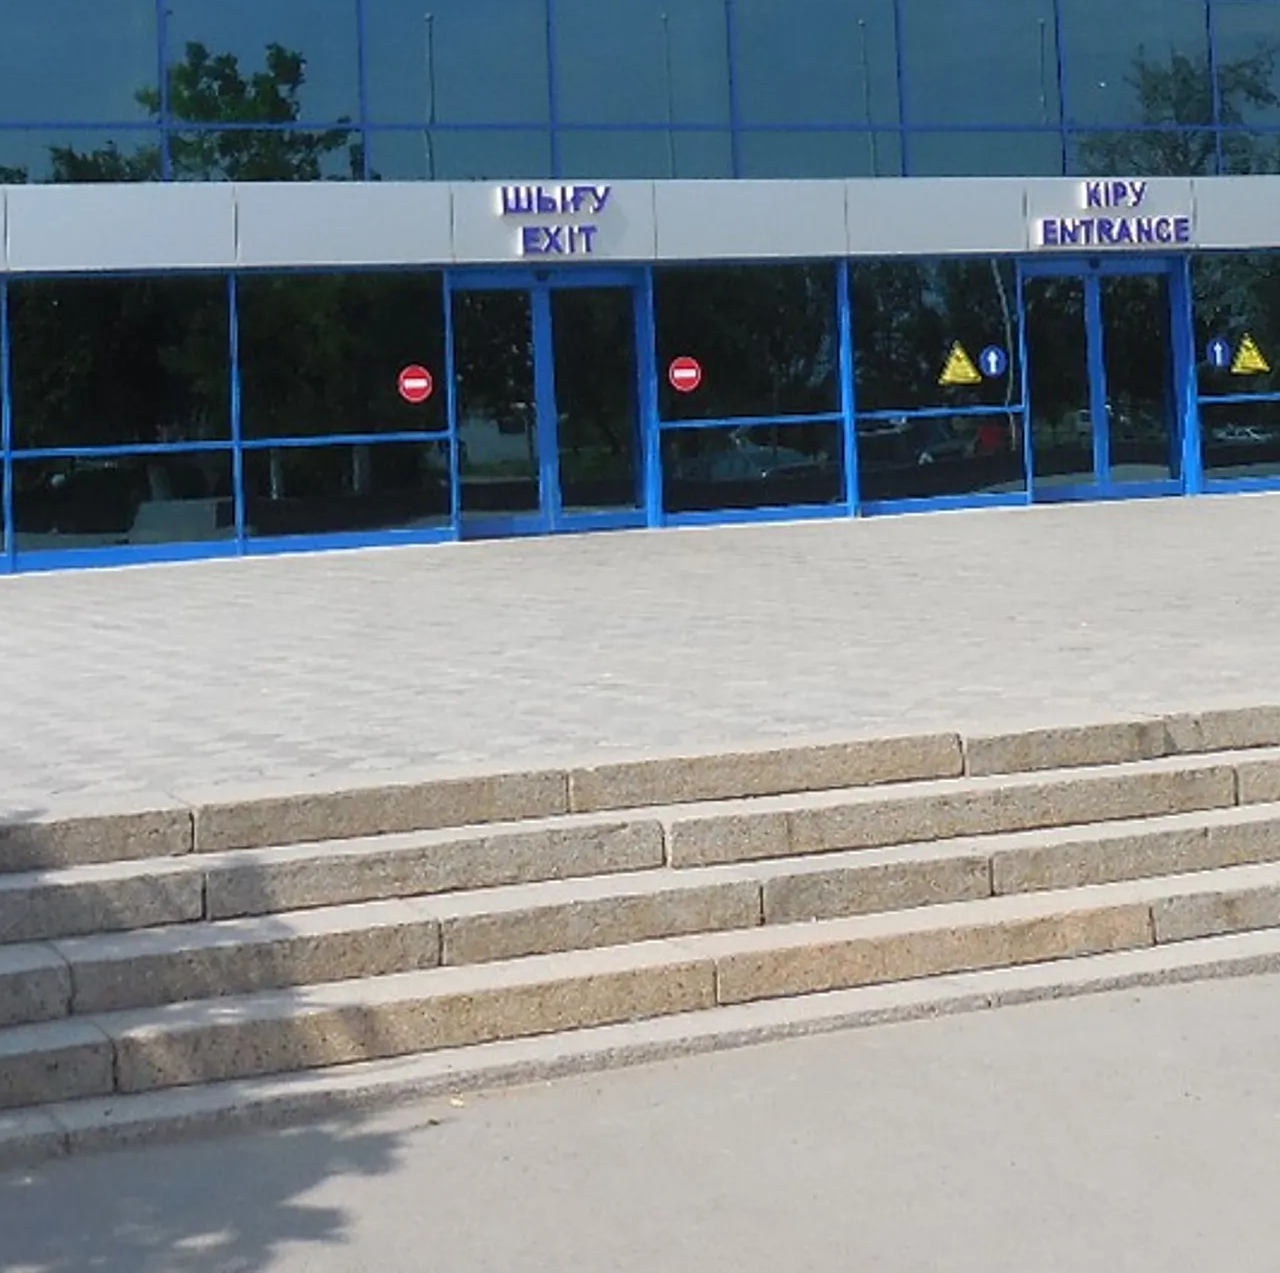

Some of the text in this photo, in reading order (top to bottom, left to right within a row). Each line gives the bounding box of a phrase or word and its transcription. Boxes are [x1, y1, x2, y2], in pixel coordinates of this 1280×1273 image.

[498, 185, 611, 215] ШЫҒУ
[519, 225, 598, 255] EXIT
[1040, 217, 1190, 245] ENTRANCE
